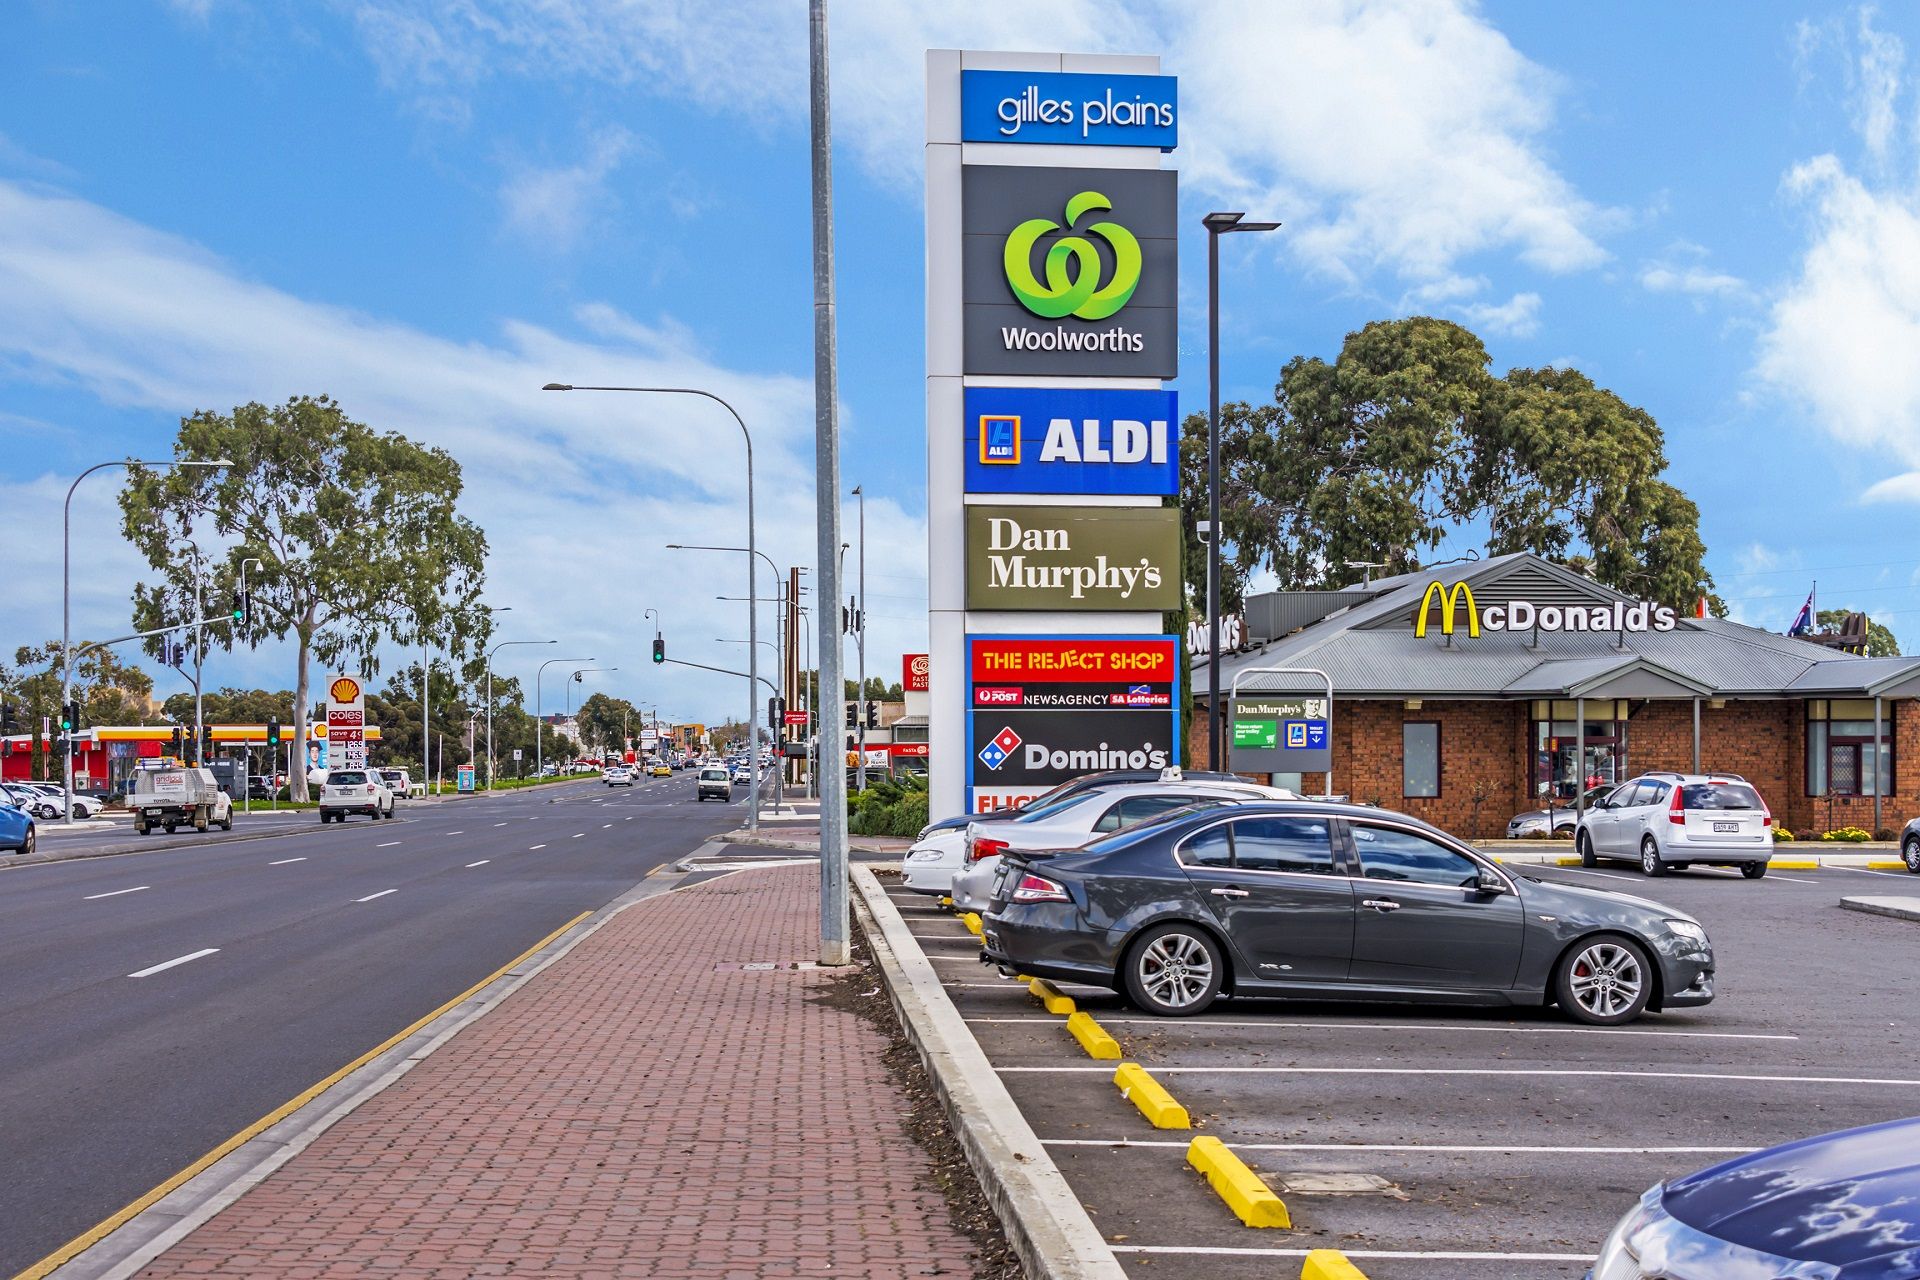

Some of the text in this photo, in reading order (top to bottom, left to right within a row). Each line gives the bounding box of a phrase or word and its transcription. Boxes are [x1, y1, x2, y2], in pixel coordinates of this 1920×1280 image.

[998, 85, 1174, 138] gilles plains
[1001, 325, 1144, 353] Woolworths
[988, 446, 1013, 456] ALDI
[1039, 418, 1168, 464] ALDI
[987, 518, 1071, 551] Dan
[987, 555, 1162, 599] Murphy's
[982, 649, 1165, 670] THE REJECT SHOP
[991, 693, 1018, 702] POST
[1024, 694, 1108, 705] NEWSAGENCY
[1112, 694, 1168, 704] SA Lotteries
[330, 710, 361, 719] coles
[1237, 704, 1301, 716] Dan Murphy's
[1025, 742, 1167, 770] Domino's
